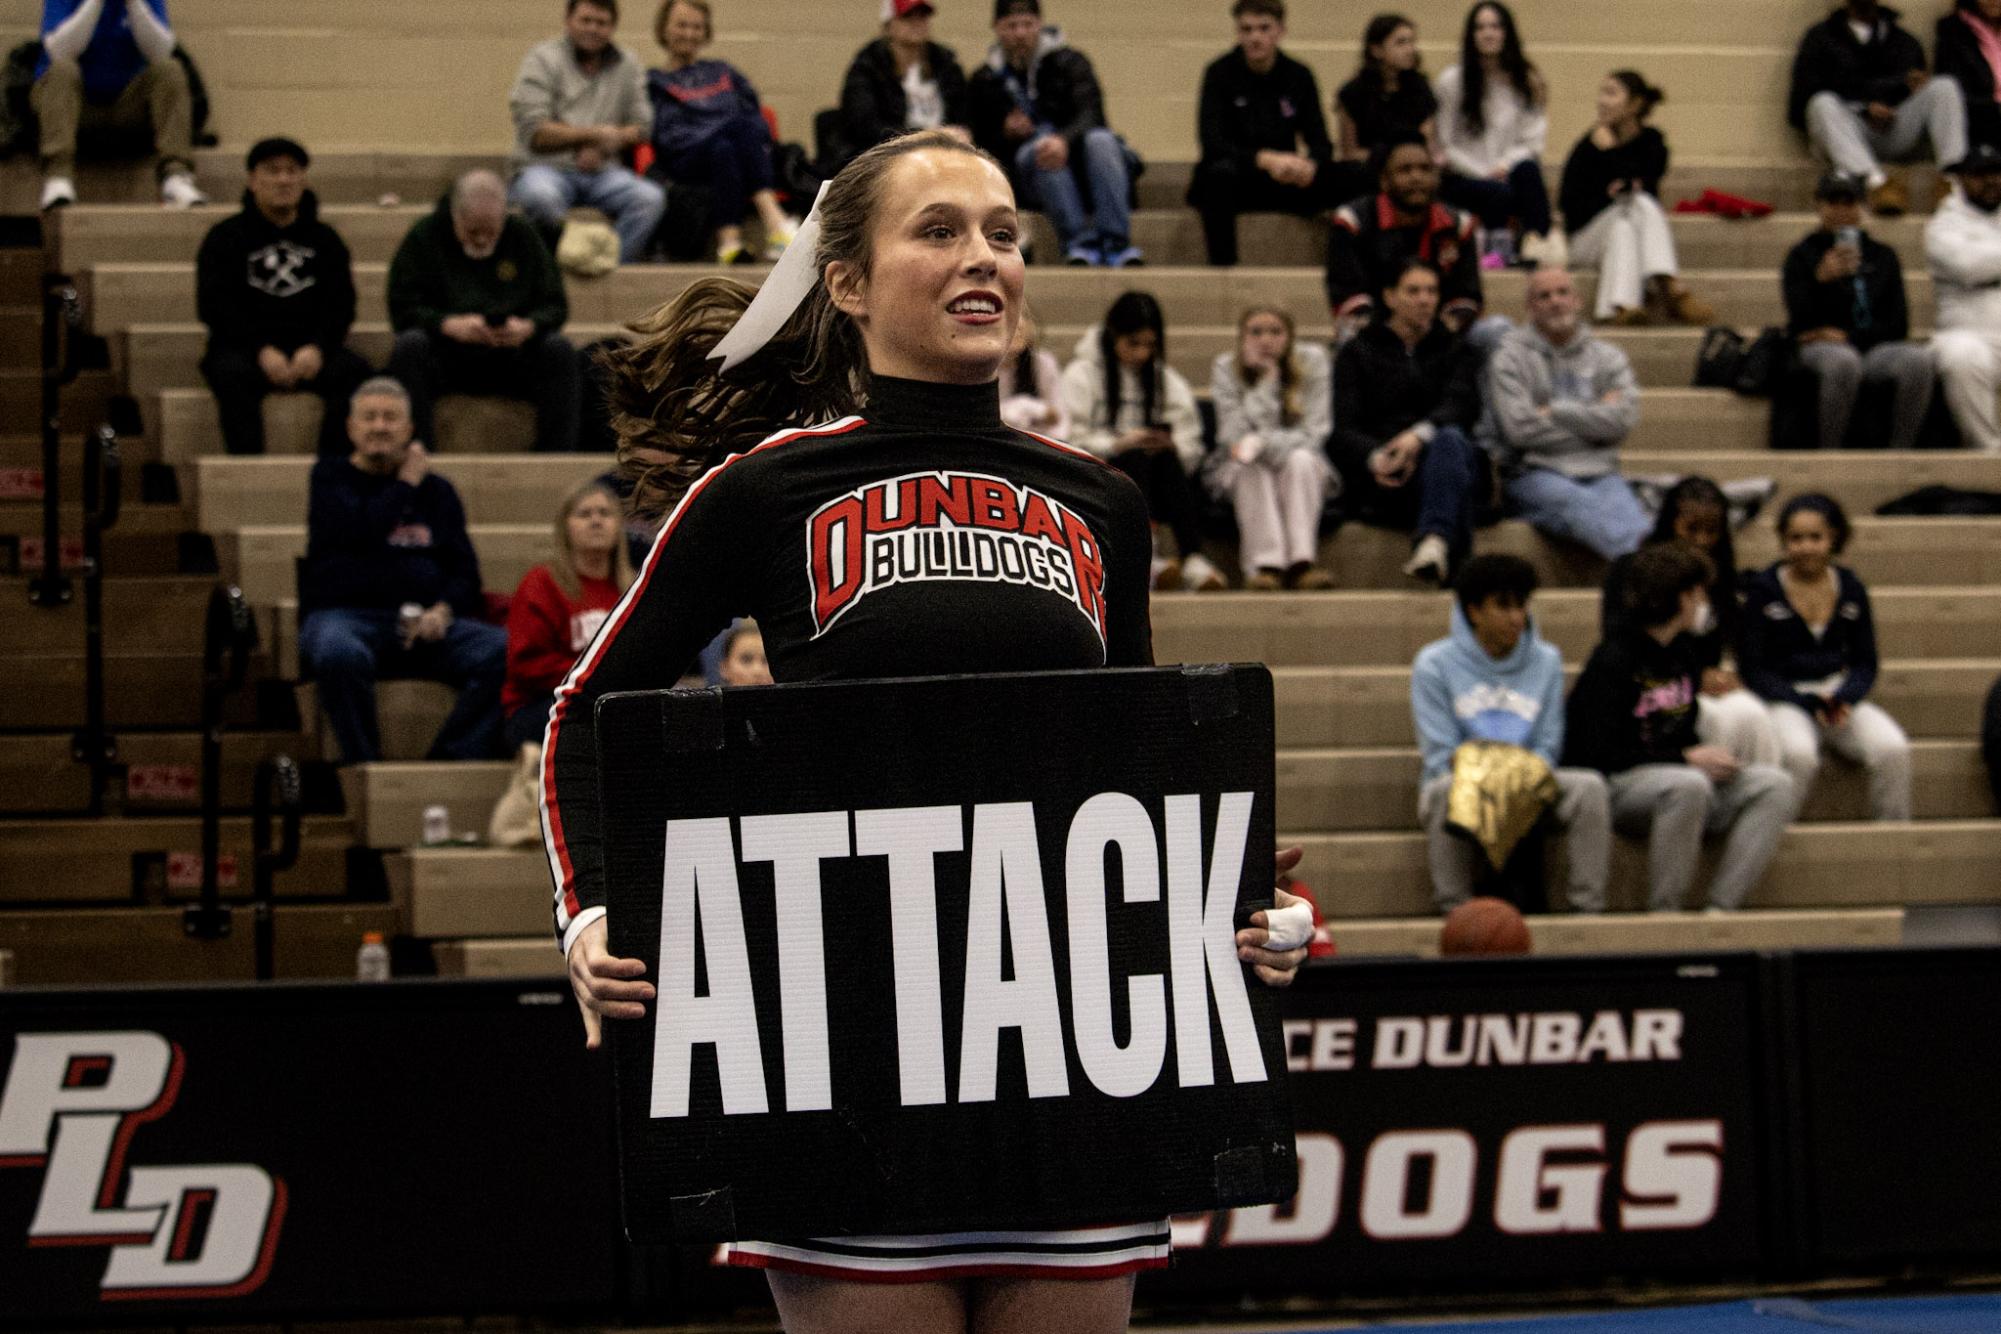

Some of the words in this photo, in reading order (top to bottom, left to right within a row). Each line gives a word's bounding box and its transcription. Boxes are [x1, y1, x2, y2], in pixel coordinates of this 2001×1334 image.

[807, 471, 1107, 645] DUNBAR
[871, 531, 1075, 597] BULLDOGS
[650, 791, 1268, 1118] ATTACK
[1371, 1008, 1684, 1069] DUNBAR
[1170, 1119, 1723, 1248] DOGS
